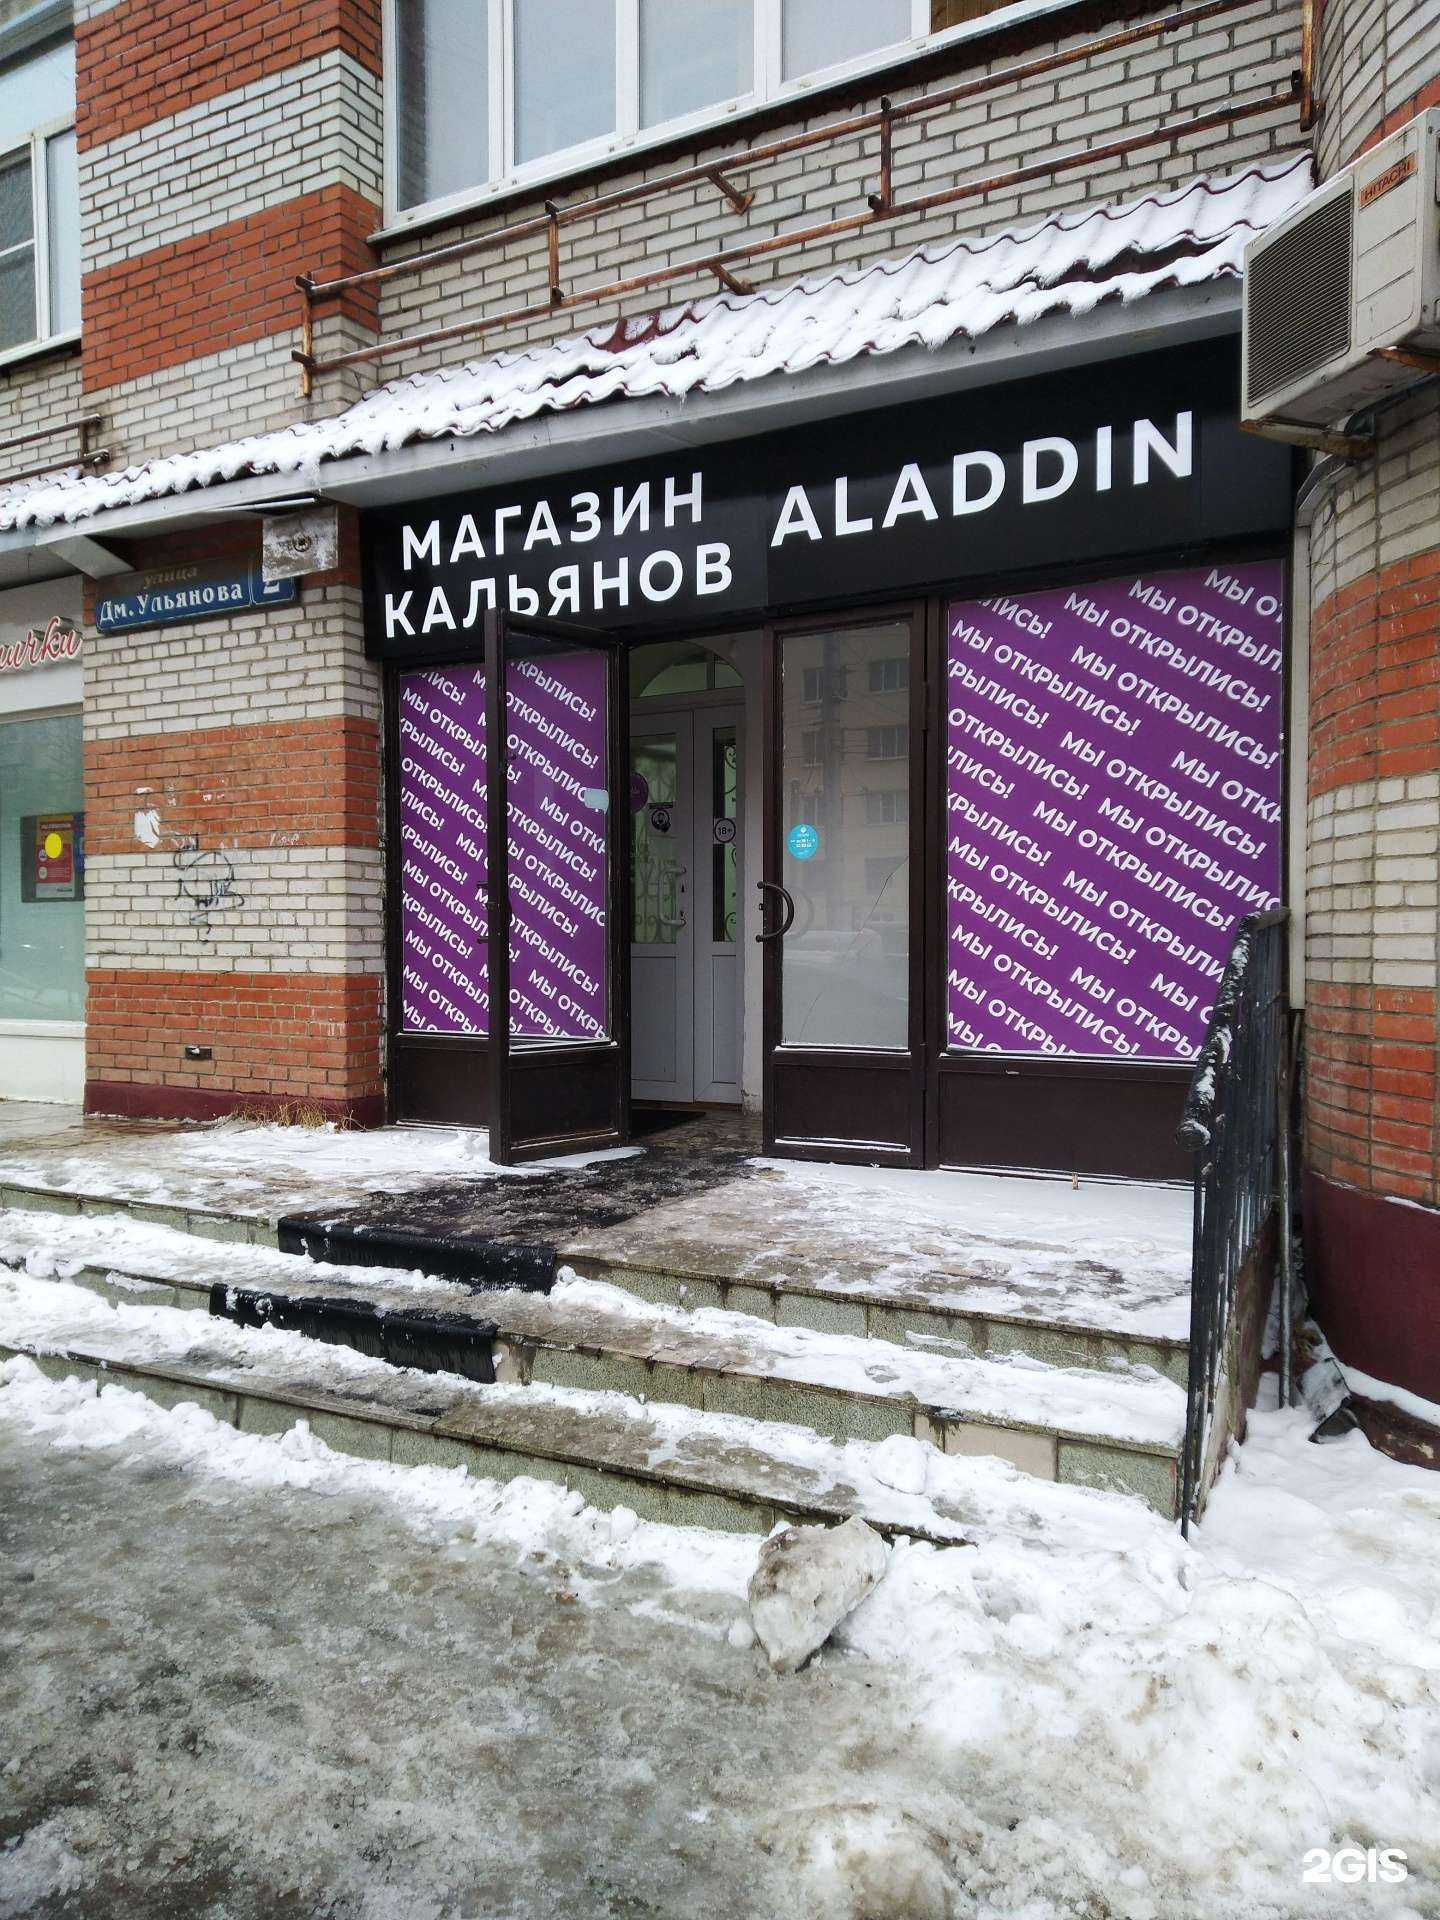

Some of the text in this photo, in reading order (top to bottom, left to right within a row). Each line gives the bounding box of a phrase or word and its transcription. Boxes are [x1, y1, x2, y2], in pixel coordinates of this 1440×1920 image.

[1364, 161, 1411, 200] HITACHI
[771, 411, 1192, 547] ALADDIN
[402, 472, 702, 570] МАГАЗИН
[385, 541, 733, 638] КАЛЬЯНОВ
[1204, 569, 1255, 605] МЫ
[0, 615, 82, 671] ички
[1128, 579, 1282, 674] МЫ ОТКРЫЛ
[1064, 592, 1271, 713] МЫ ОТКРЫЛИСЬ!
[952, 620, 1142, 736] МЫ ОТКРЫЛИСЬ!
[403, 688, 429, 715] МЫ
[1070, 645, 1279, 770] МЫ ОТКРЫЛИСЬ!
[948, 708, 1090, 801] ОТКРЫЛИСЬ!
[1171, 751, 1221, 788] МЫ
[540, 796, 570, 826] МЫ
[1060, 731, 1267, 859] МЫ ОТКРЫЛИСЬ!
[717, 826, 733, 836] 18+
[1098, 798, 1144, 834] МЫ
[456, 832, 483, 862] МЫ
[1033, 801, 1236, 932] МЫ ОТКРЫЛИСЬ!
[403, 859, 429, 888] МЫ
[1063, 870, 1109, 906] МЫ
[948, 836, 1137, 965] МЫ ОТКРЫЛИСЬ!
[405, 929, 432, 958] МЫ
[403, 965, 428, 994] МЫ
[528, 969, 557, 999] МЫ
[948, 969, 988, 1005] МЫ
[952, 925, 1141, 1056] МЫ ОТКРЫЛИСЬ!
[1070, 967, 1116, 1005] МЫ
[1150, 973, 1199, 1012] МЫ
